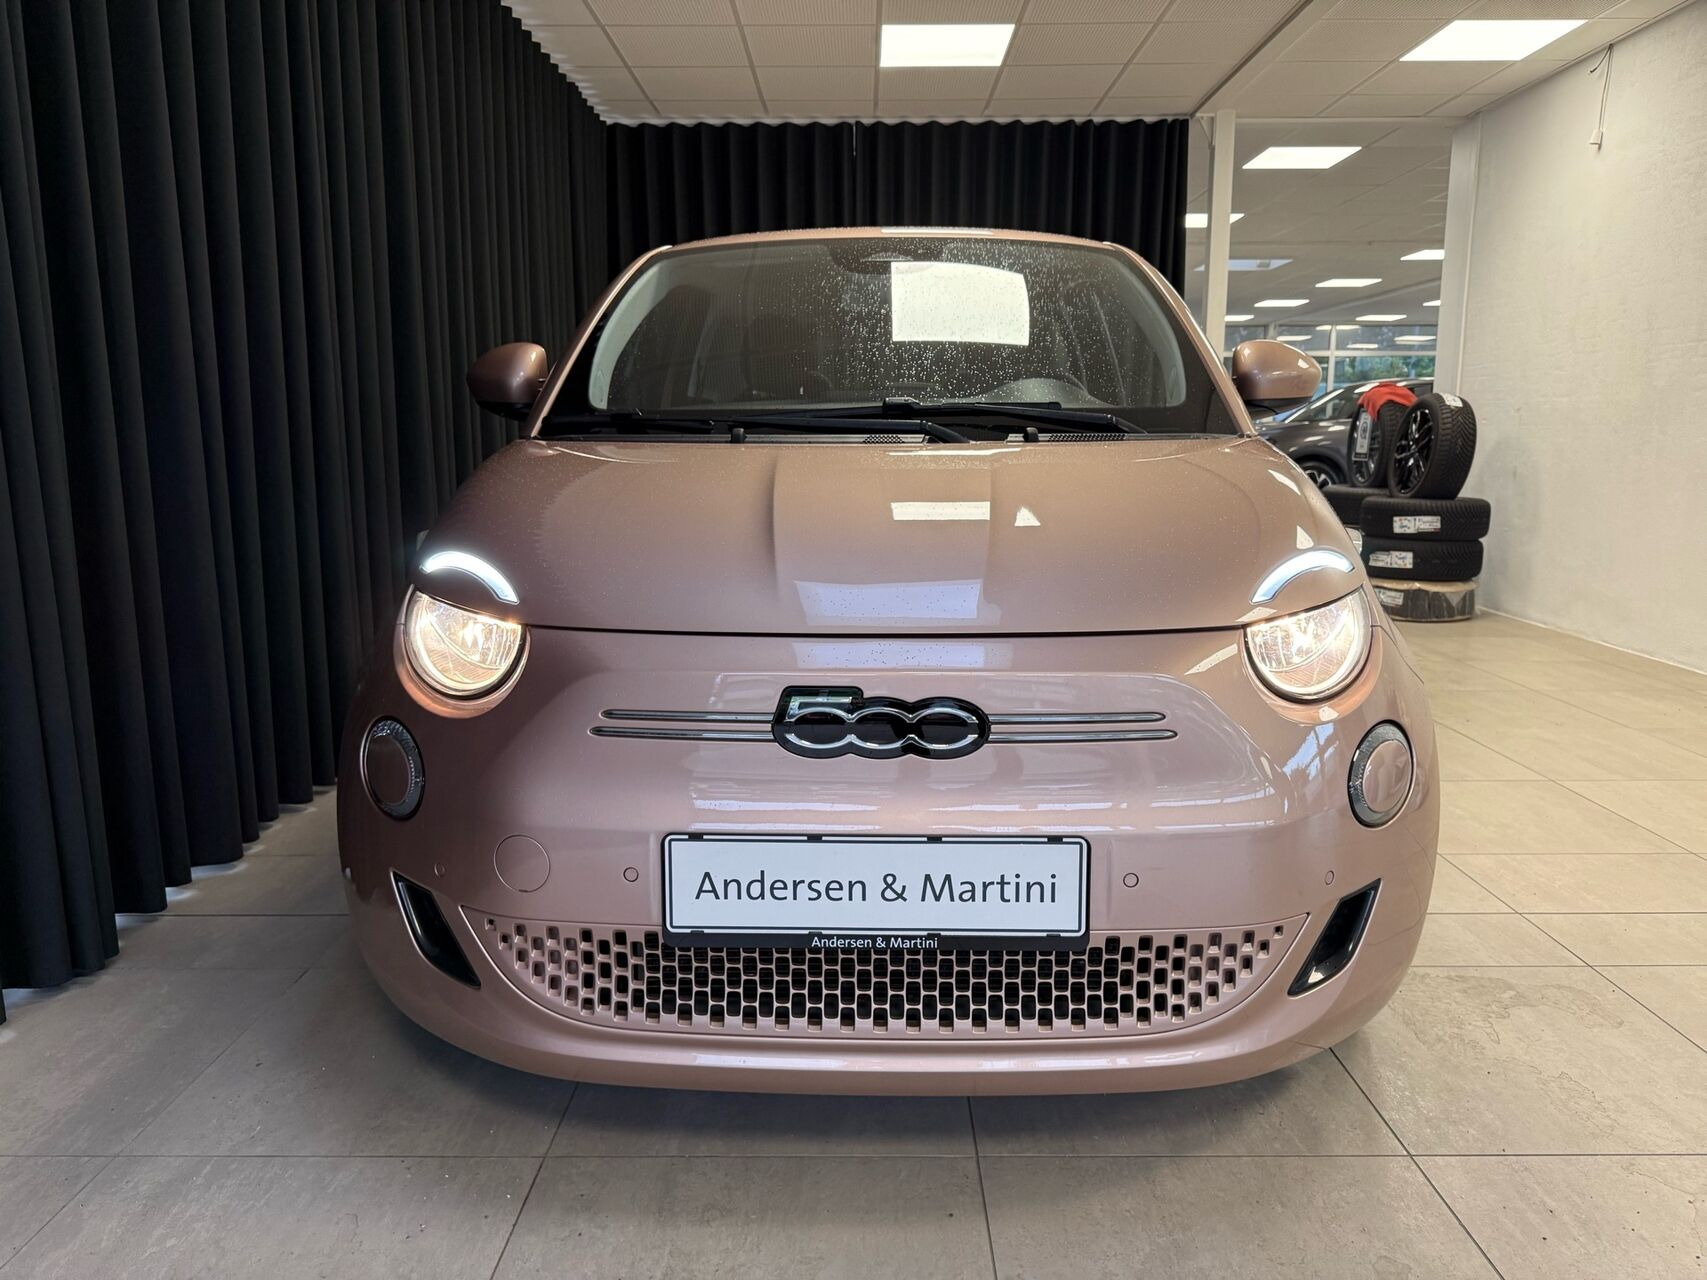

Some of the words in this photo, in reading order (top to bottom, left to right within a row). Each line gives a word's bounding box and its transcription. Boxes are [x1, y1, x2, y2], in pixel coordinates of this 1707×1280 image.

[695, 870, 867, 902] Andersen
[880, 873, 907, 902] &
[920, 872, 1058, 904] Martini
[811, 936, 872, 948] Andersen
[876, 937, 886, 948] &
[889, 937, 938, 948] Martini
